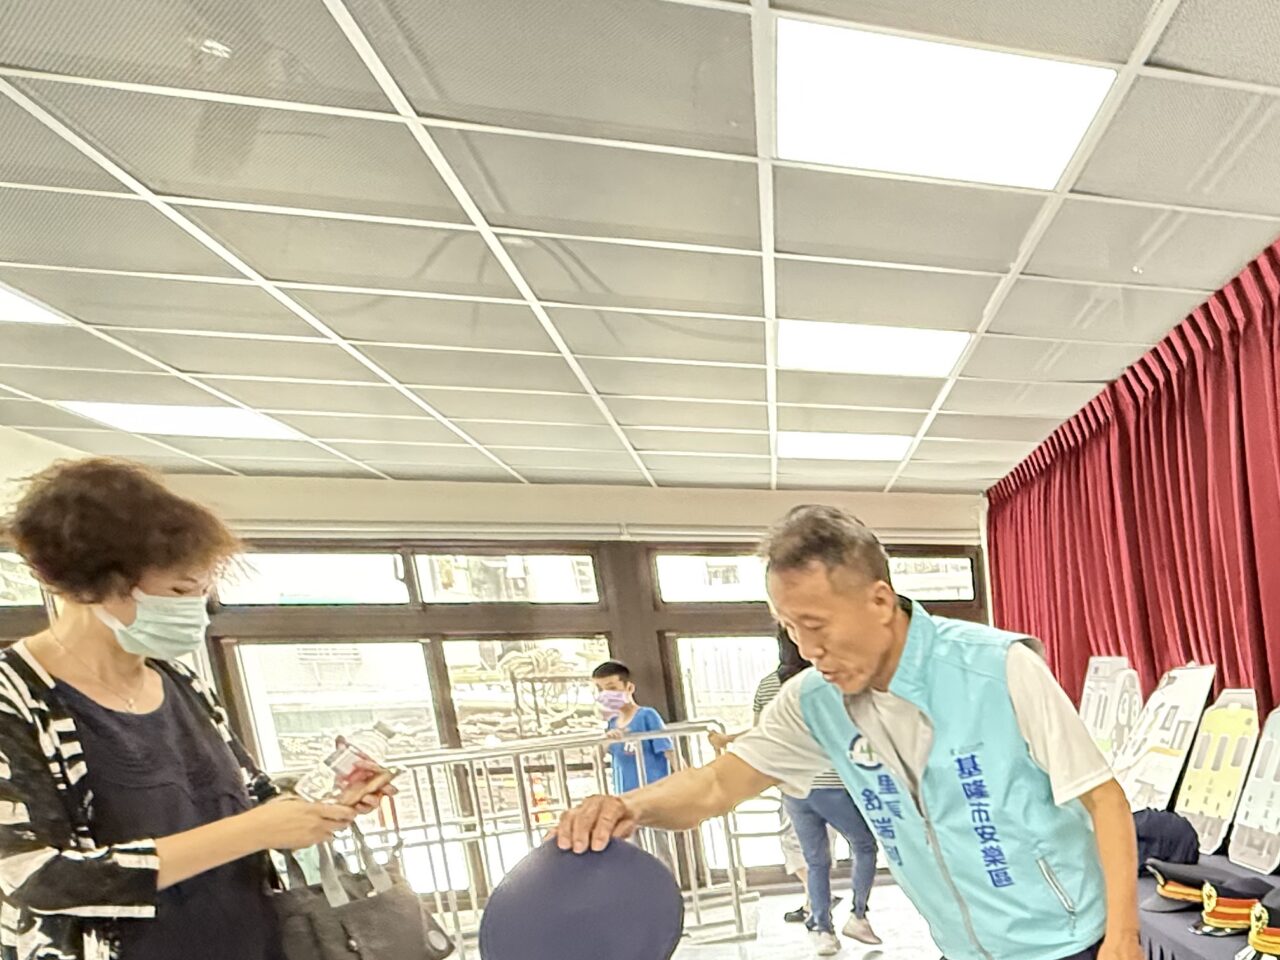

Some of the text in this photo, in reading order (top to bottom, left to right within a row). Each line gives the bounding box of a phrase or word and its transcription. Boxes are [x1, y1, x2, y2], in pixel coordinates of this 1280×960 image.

[954, 754, 1016, 888] 基隆市安樂區
